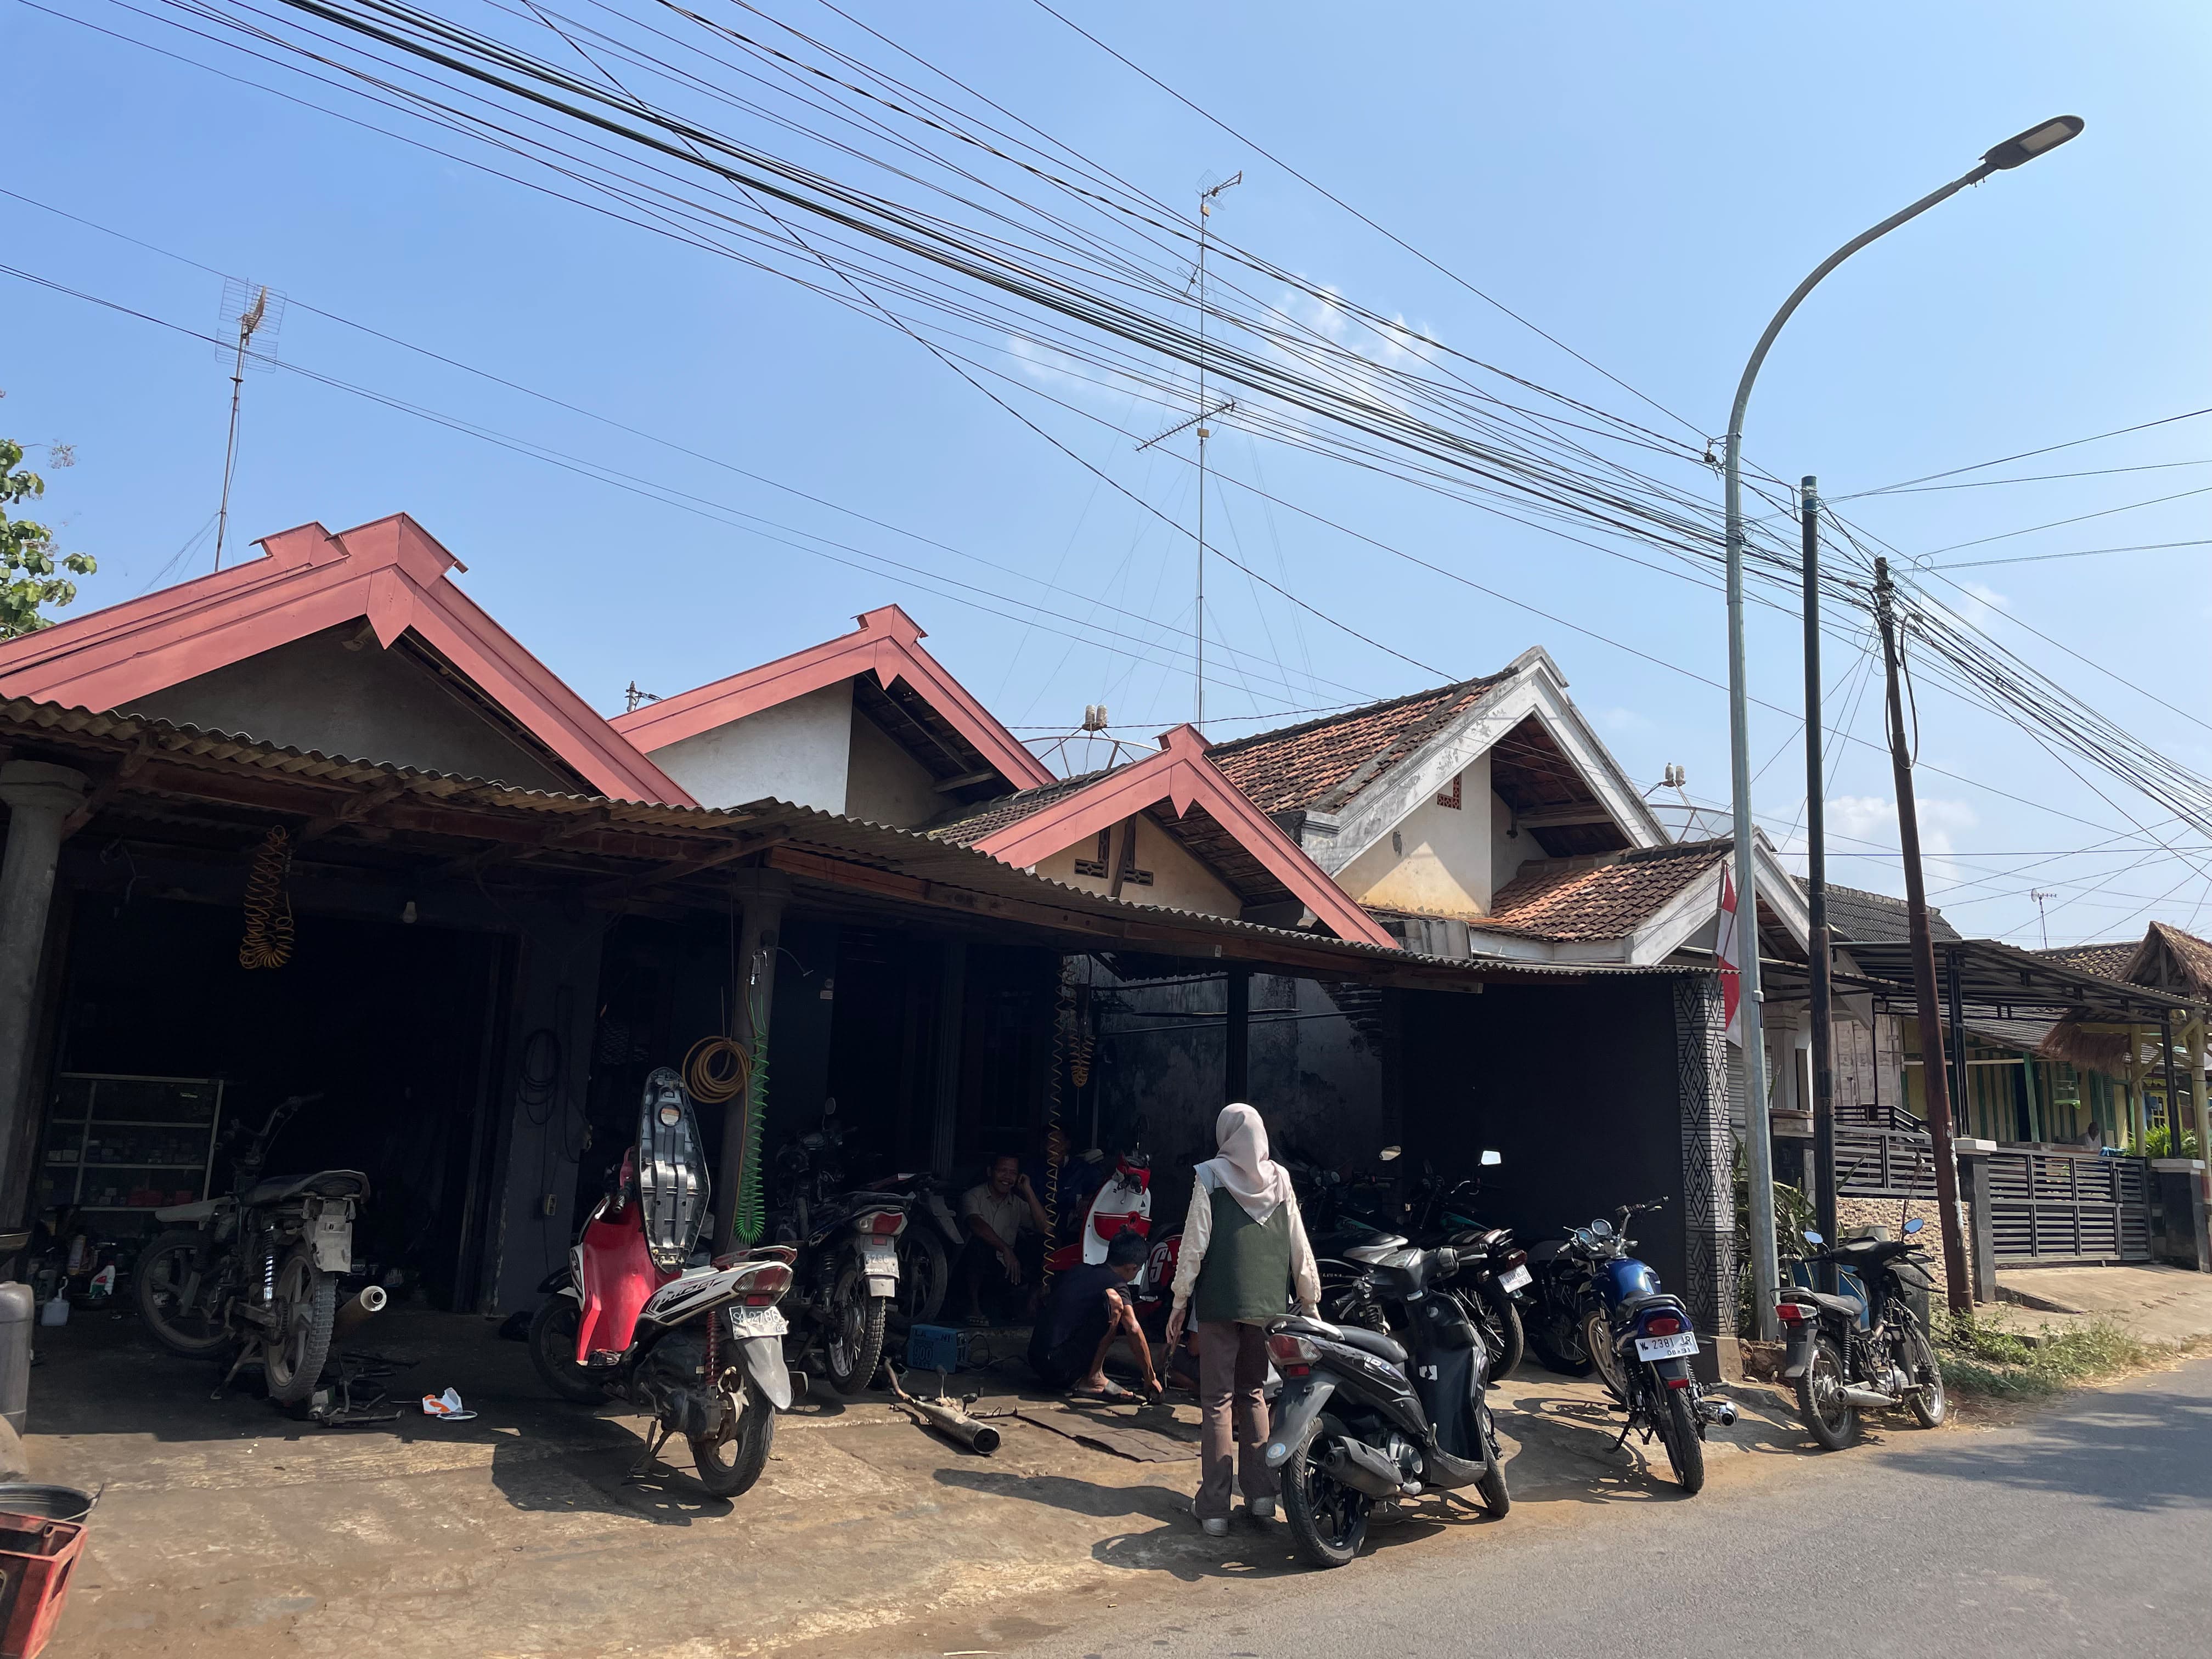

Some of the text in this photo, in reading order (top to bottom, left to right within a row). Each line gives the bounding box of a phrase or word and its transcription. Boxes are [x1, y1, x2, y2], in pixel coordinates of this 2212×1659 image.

[749, 1310, 780, 1324] 2786
[1652, 1338, 1674, 1350] 2381
[1680, 1336, 1692, 1346] JR
[913, 1345, 934, 1362] 900
